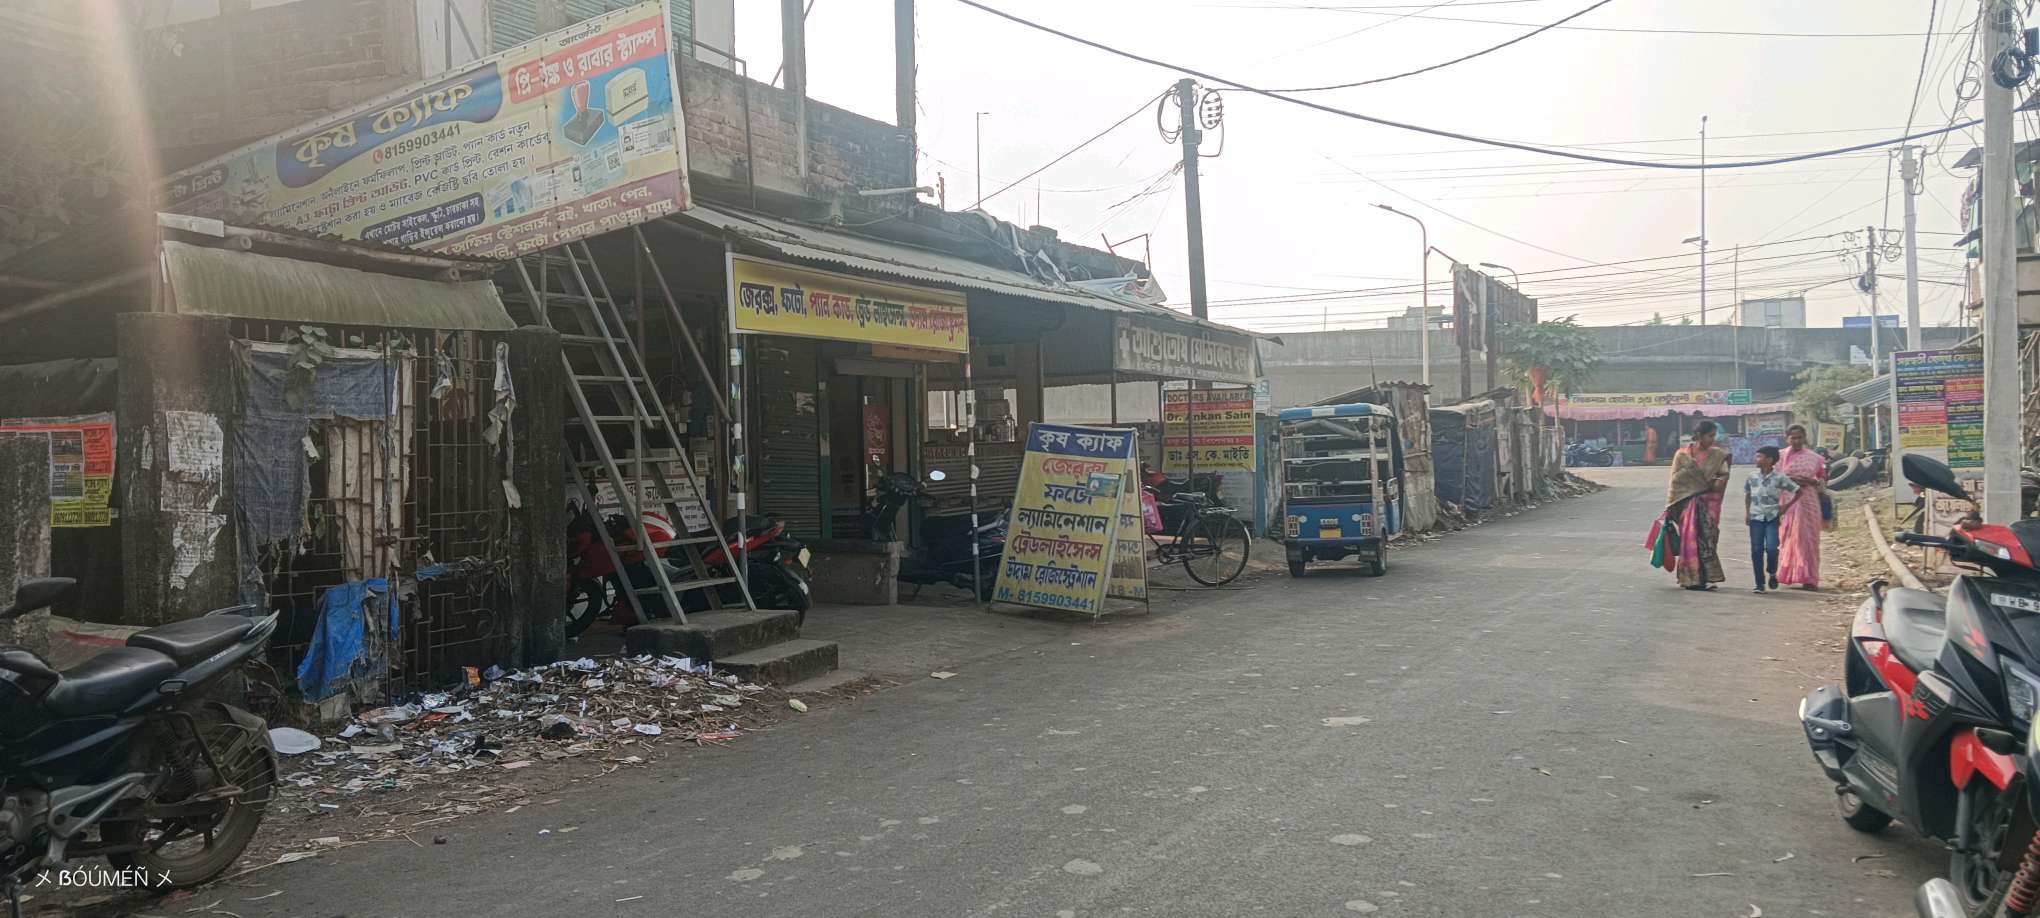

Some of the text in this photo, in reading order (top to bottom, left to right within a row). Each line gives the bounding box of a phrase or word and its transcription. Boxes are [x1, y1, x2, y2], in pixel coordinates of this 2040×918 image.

[563, 58, 573, 77] ও
[577, 43, 614, 76] রাবার
[616, 27, 657, 60] স্ট্যাম্প
[291, 79, 473, 168] কৃষ ক্যাফ
[508, 121, 531, 140] নতুন
[384, 122, 461, 160] 8159903441
[414, 168, 439, 186] PVC
[482, 164, 510, 180] তোলা
[450, 232, 492, 254] অফিস
[557, 207, 578, 223] বই,
[582, 194, 616, 214] খাতা,
[518, 198, 673, 251] ফটো পেপার পাওয়া যায়
[1167, 391, 1250, 402] DOCTRS AVAILABLE
[1167, 413, 1182, 421] Dr.
[1225, 411, 1251, 420] Sain
[1038, 430, 1124, 452] কৃষ ক্যাফ
[1018, 504, 1109, 534] ল্যামিনেশান
[1013, 529, 1103, 561] ট্রেডলাইসেন্স
[1006, 556, 1032, 582] উদ্যম
[998, 586, 1096, 611] M- 8159903441
